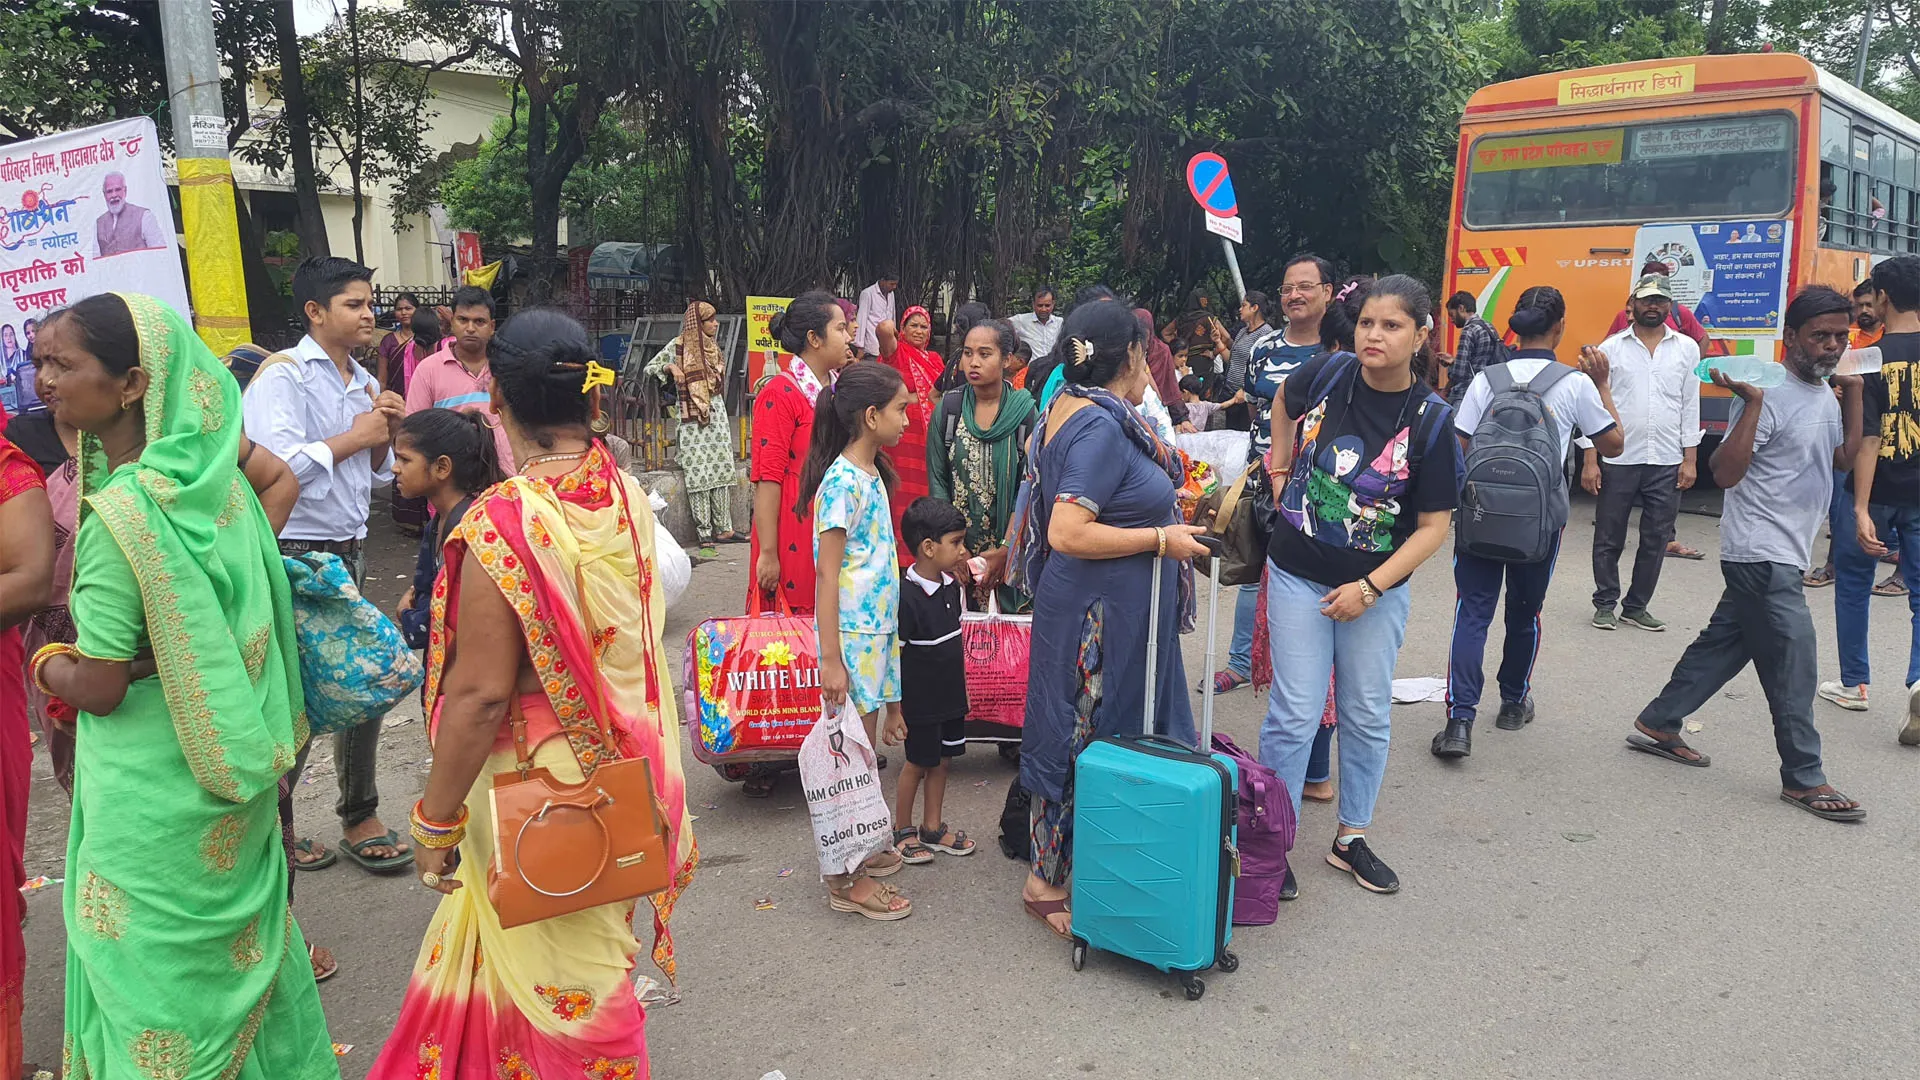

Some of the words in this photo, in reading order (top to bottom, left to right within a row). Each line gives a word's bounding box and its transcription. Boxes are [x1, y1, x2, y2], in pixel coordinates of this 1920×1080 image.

[1570, 78, 1647, 99] सिद्धार्थनगर
[1652, 71, 1683, 90] डिपो
[0, 157, 31, 182] परिवहन
[60, 144, 98, 177] मुरादाबाद
[100, 138, 115, 161] क्षेत्र
[41, 231, 79, 250] त्योहार
[61, 251, 85, 275] को
[13, 288, 67, 312] उपहार
[727, 668, 790, 691] WHITE
[735, 709, 759, 717] WORLD
[760, 708, 780, 716] CLASS
[807, 788, 826, 802] RAM
[857, 817, 888, 835] Dress
